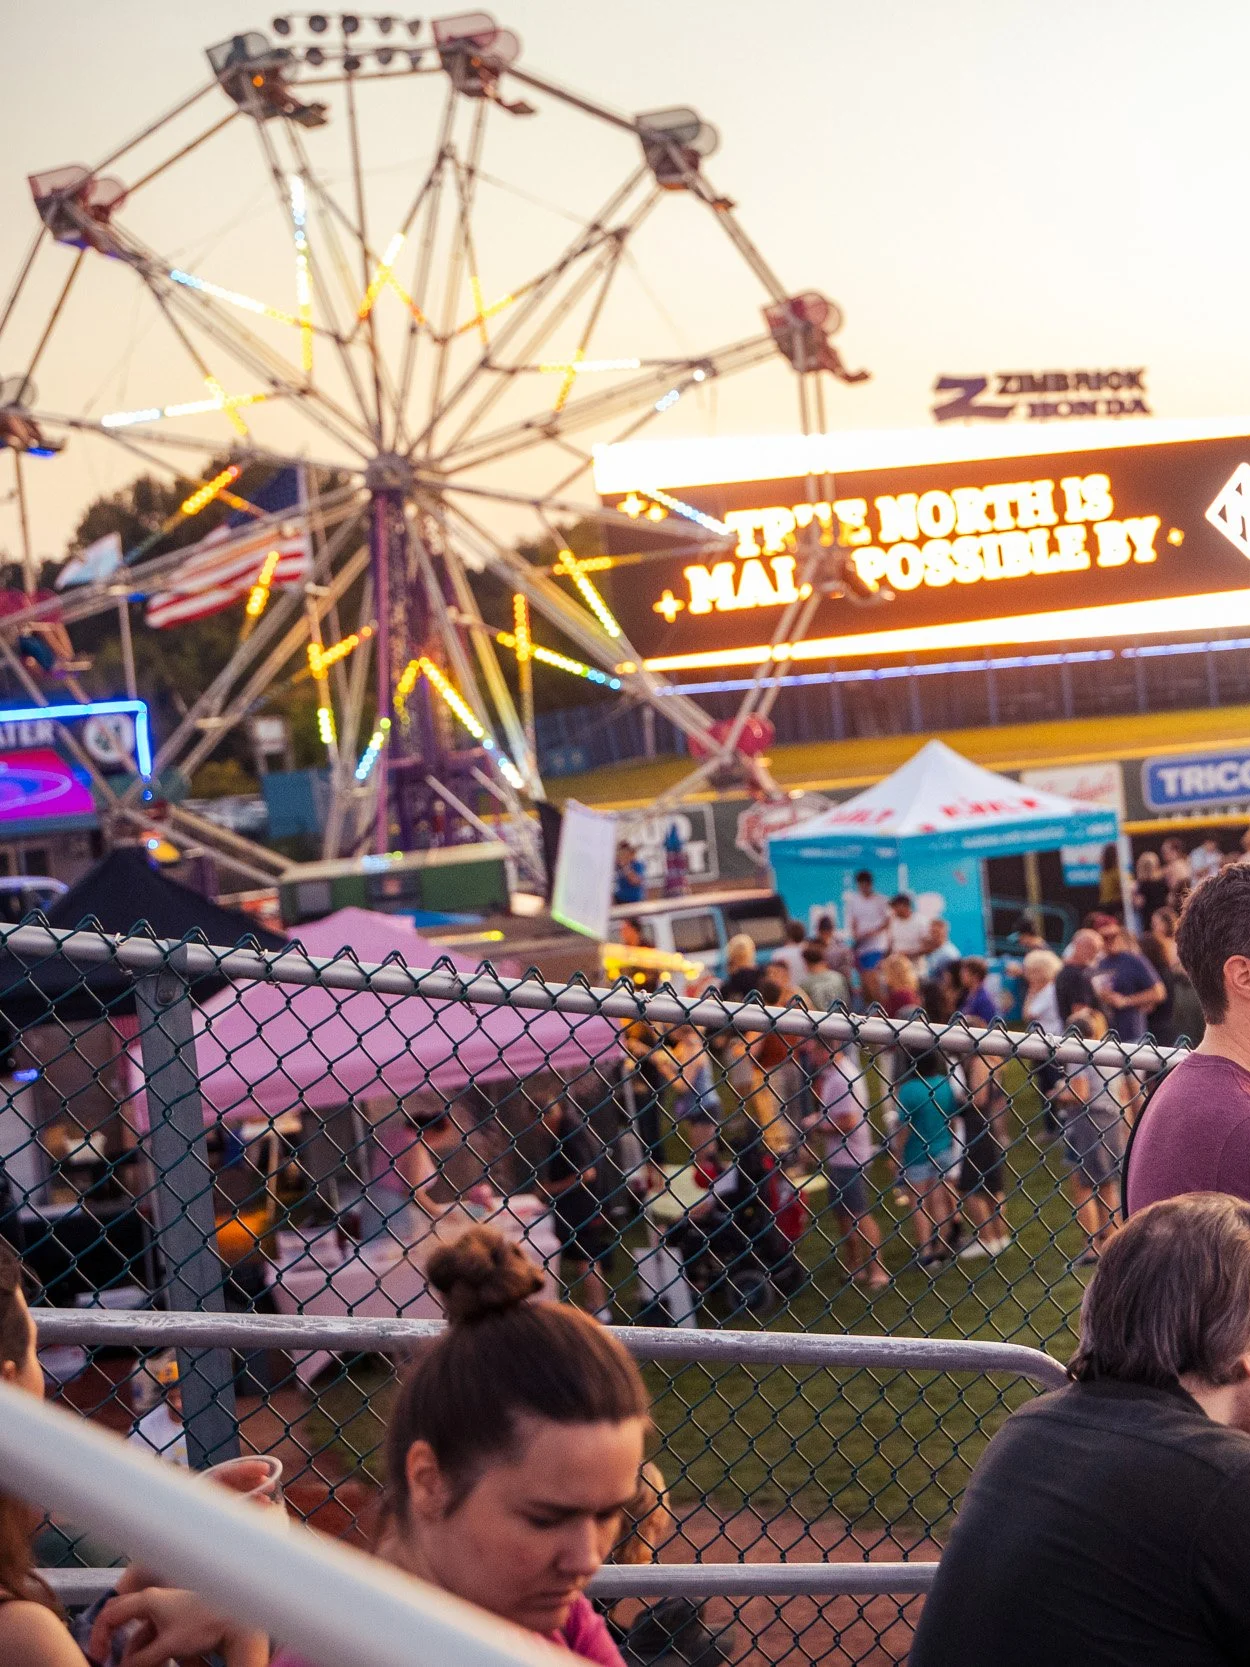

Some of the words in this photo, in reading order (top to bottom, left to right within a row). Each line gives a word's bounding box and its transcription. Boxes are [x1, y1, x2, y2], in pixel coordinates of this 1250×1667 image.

[997, 370, 1146, 394] ZIMBRICK
[1028, 400, 1150, 418] HONDA
[874, 478, 1058, 543] NORTH
[1060, 474, 1114, 523] IS
[851, 523, 1091, 591] POSSIBLE
[1093, 515, 1161, 568] BY
